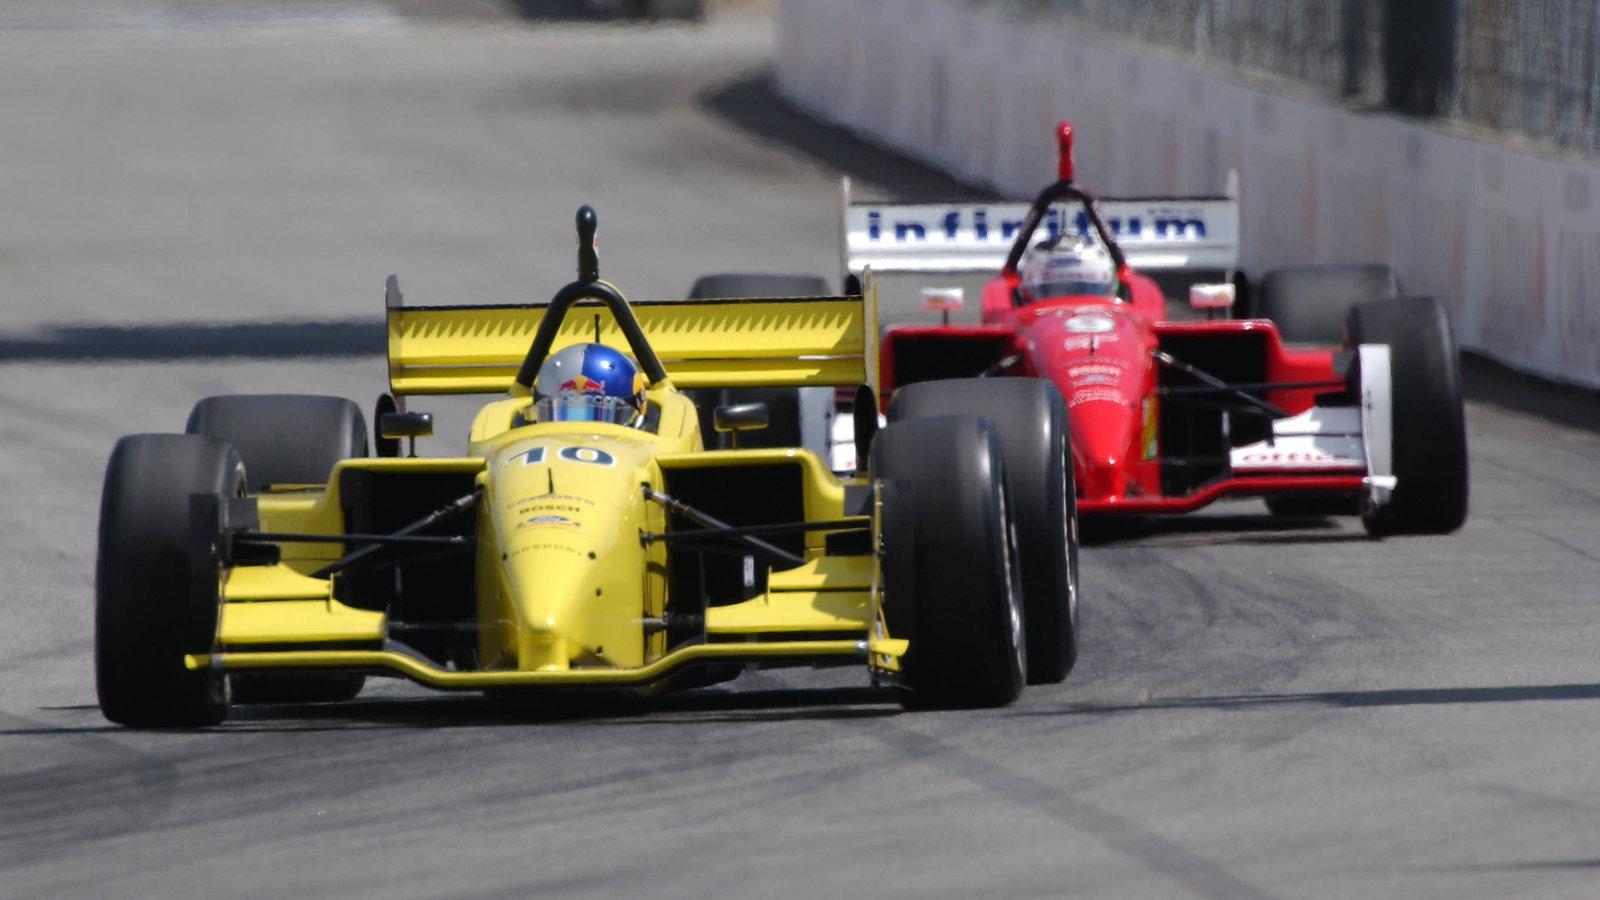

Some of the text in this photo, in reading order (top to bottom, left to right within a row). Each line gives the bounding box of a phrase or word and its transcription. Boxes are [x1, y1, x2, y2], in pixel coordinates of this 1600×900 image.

[867, 210, 1207, 241] infinitum
[506, 446, 615, 468] 10
[518, 505, 581, 515] BOSCH
